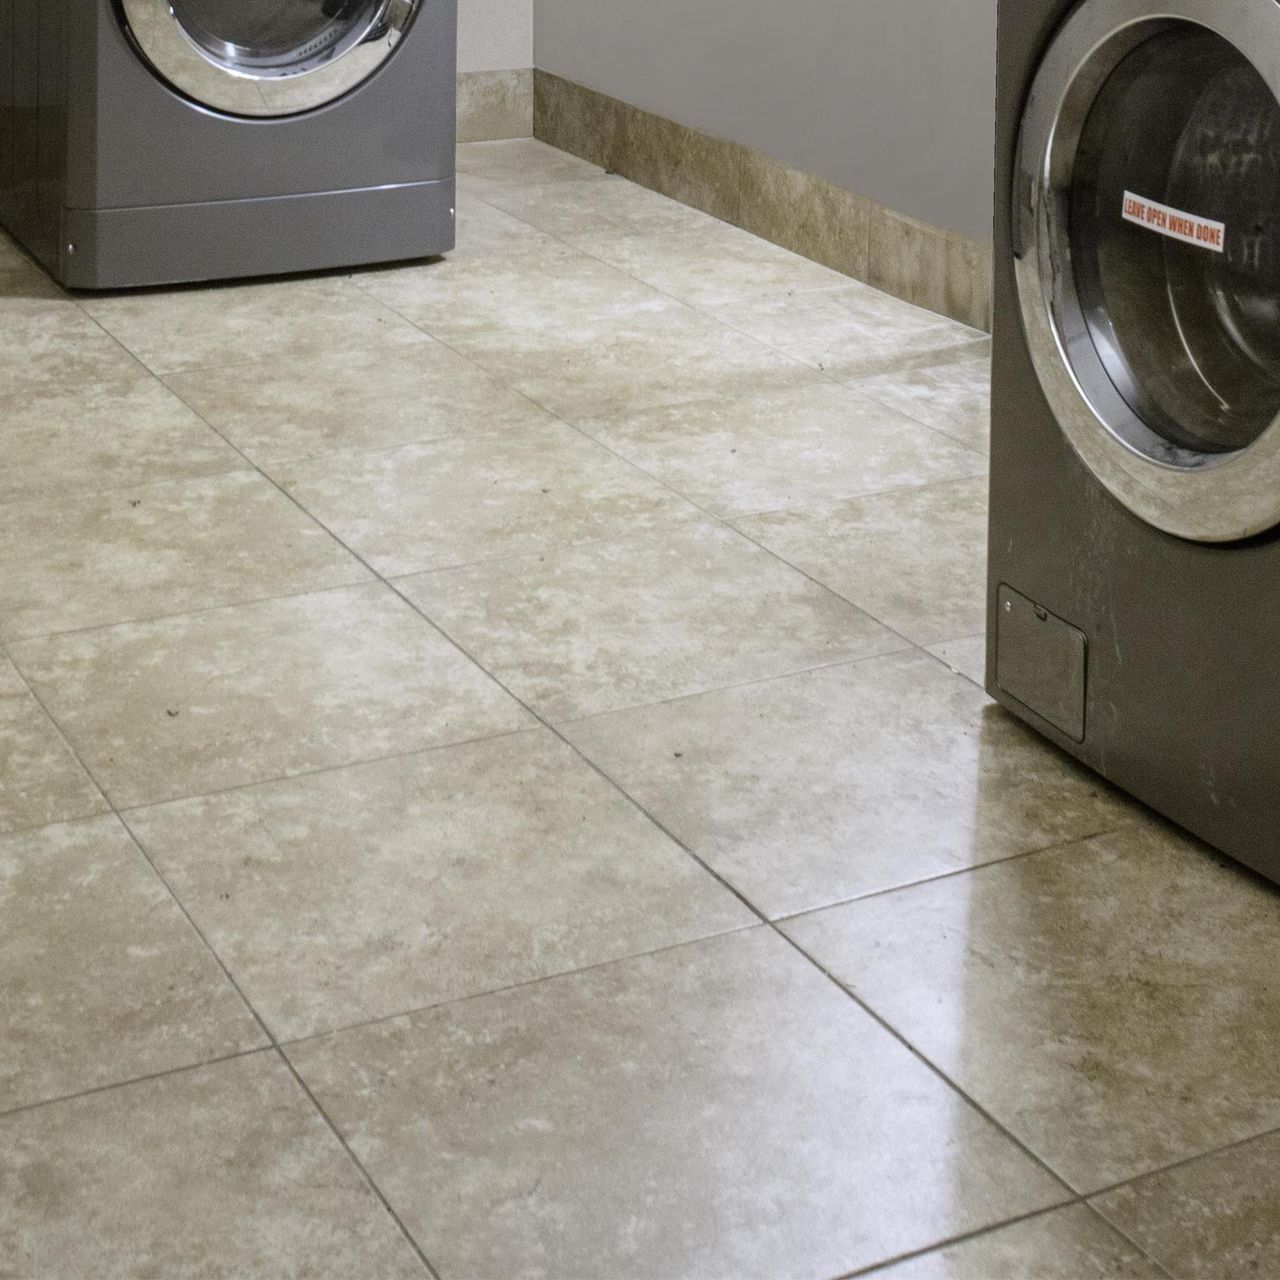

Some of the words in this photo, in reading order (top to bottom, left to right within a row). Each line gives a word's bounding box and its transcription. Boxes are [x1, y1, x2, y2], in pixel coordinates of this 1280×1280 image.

[1124, 198, 1146, 220] LEAVE
[1147, 206, 1168, 229] OPEN
[1168, 213, 1194, 237] WHEN
[1196, 224, 1221, 246] DONE
